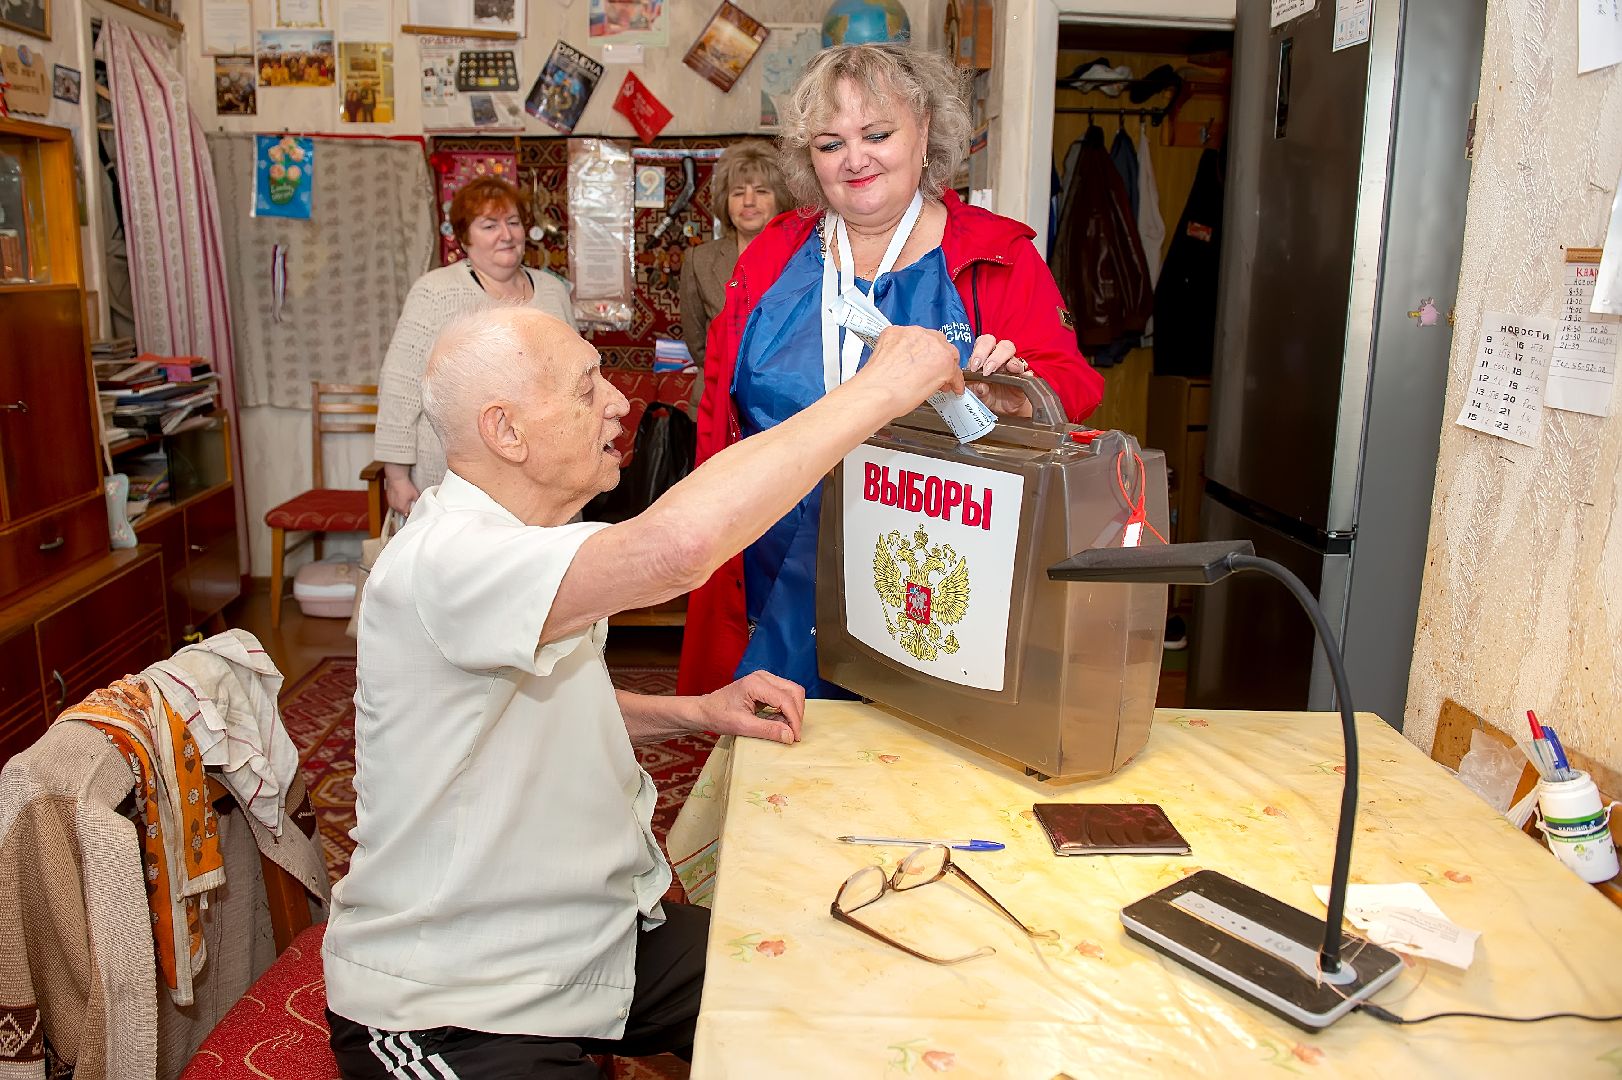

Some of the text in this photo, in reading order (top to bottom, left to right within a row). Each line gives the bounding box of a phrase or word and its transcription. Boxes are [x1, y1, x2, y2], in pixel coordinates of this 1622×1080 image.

[939, 321, 971, 334] ЛЬНАЯ
[1500, 325, 1550, 341] НОВОСТИ
[1486, 335, 1493, 343] 9
[1516, 341, 1525, 350] 16
[1484, 347, 1493, 355] 10
[1514, 352, 1524, 361] 17
[1481, 360, 1489, 368] 11
[1512, 367, 1522, 376] 18
[1479, 374, 1490, 382] 12
[1475, 387, 1485, 396] 13
[1502, 393, 1516, 404] 20
[1471, 399, 1482, 409] 14
[1499, 407, 1511, 416] 21
[1467, 412, 1478, 421] 15
[1494, 420, 1510, 431] 22
[863, 461, 993, 531] ВЫБОРЫ
